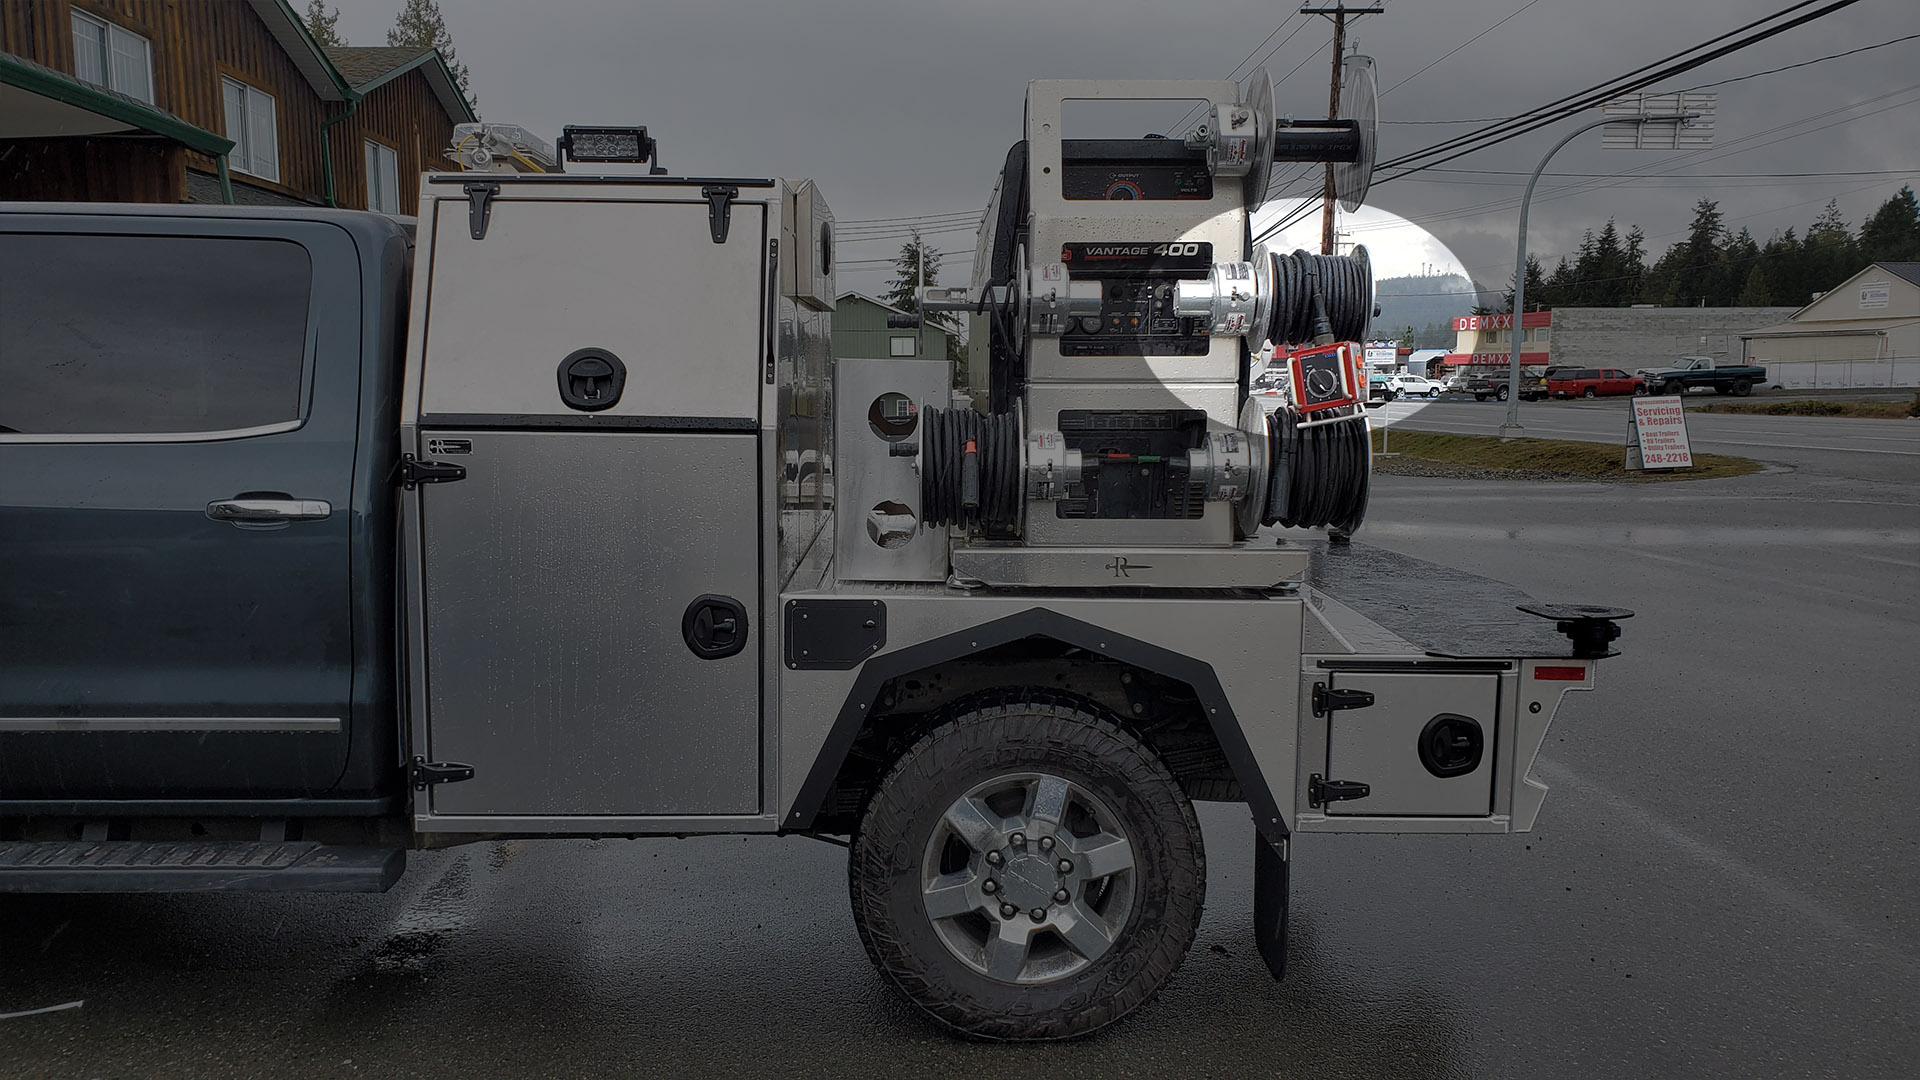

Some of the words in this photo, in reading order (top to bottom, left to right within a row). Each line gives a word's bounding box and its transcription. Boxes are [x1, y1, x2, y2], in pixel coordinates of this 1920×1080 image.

[1085, 246, 1150, 256] VANTAGE
[1153, 243, 1200, 257] 400
[1460, 315, 1510, 330] DEMXX
[1473, 355, 1512, 363] DEMXX
[1637, 407, 1680, 416] Servicing
[1638, 418, 1645, 426] &
[1647, 416, 1682, 425] Repairs
[1645, 453, 1688, 463] 248-2218
